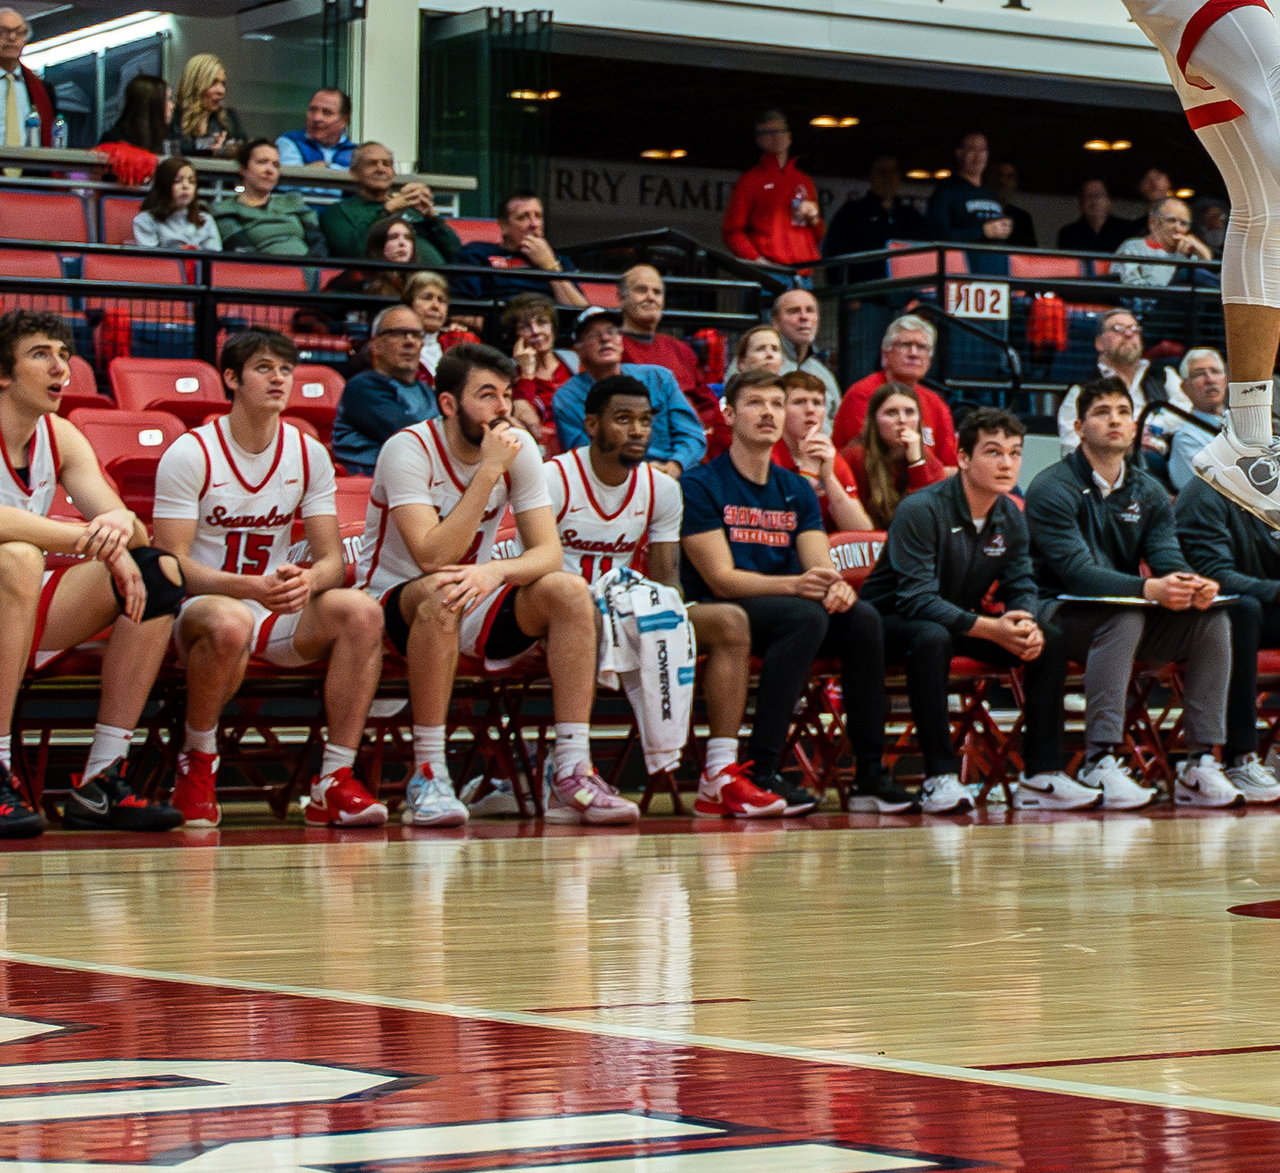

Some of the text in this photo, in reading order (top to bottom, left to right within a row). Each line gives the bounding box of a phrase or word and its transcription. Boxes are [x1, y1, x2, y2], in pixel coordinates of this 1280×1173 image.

[639, 175, 729, 210] FAMI
[963, 287, 1002, 314] 102
[221, 531, 275, 575] 15
[829, 542, 870, 571] STONY
[580, 555, 612, 584] 11
